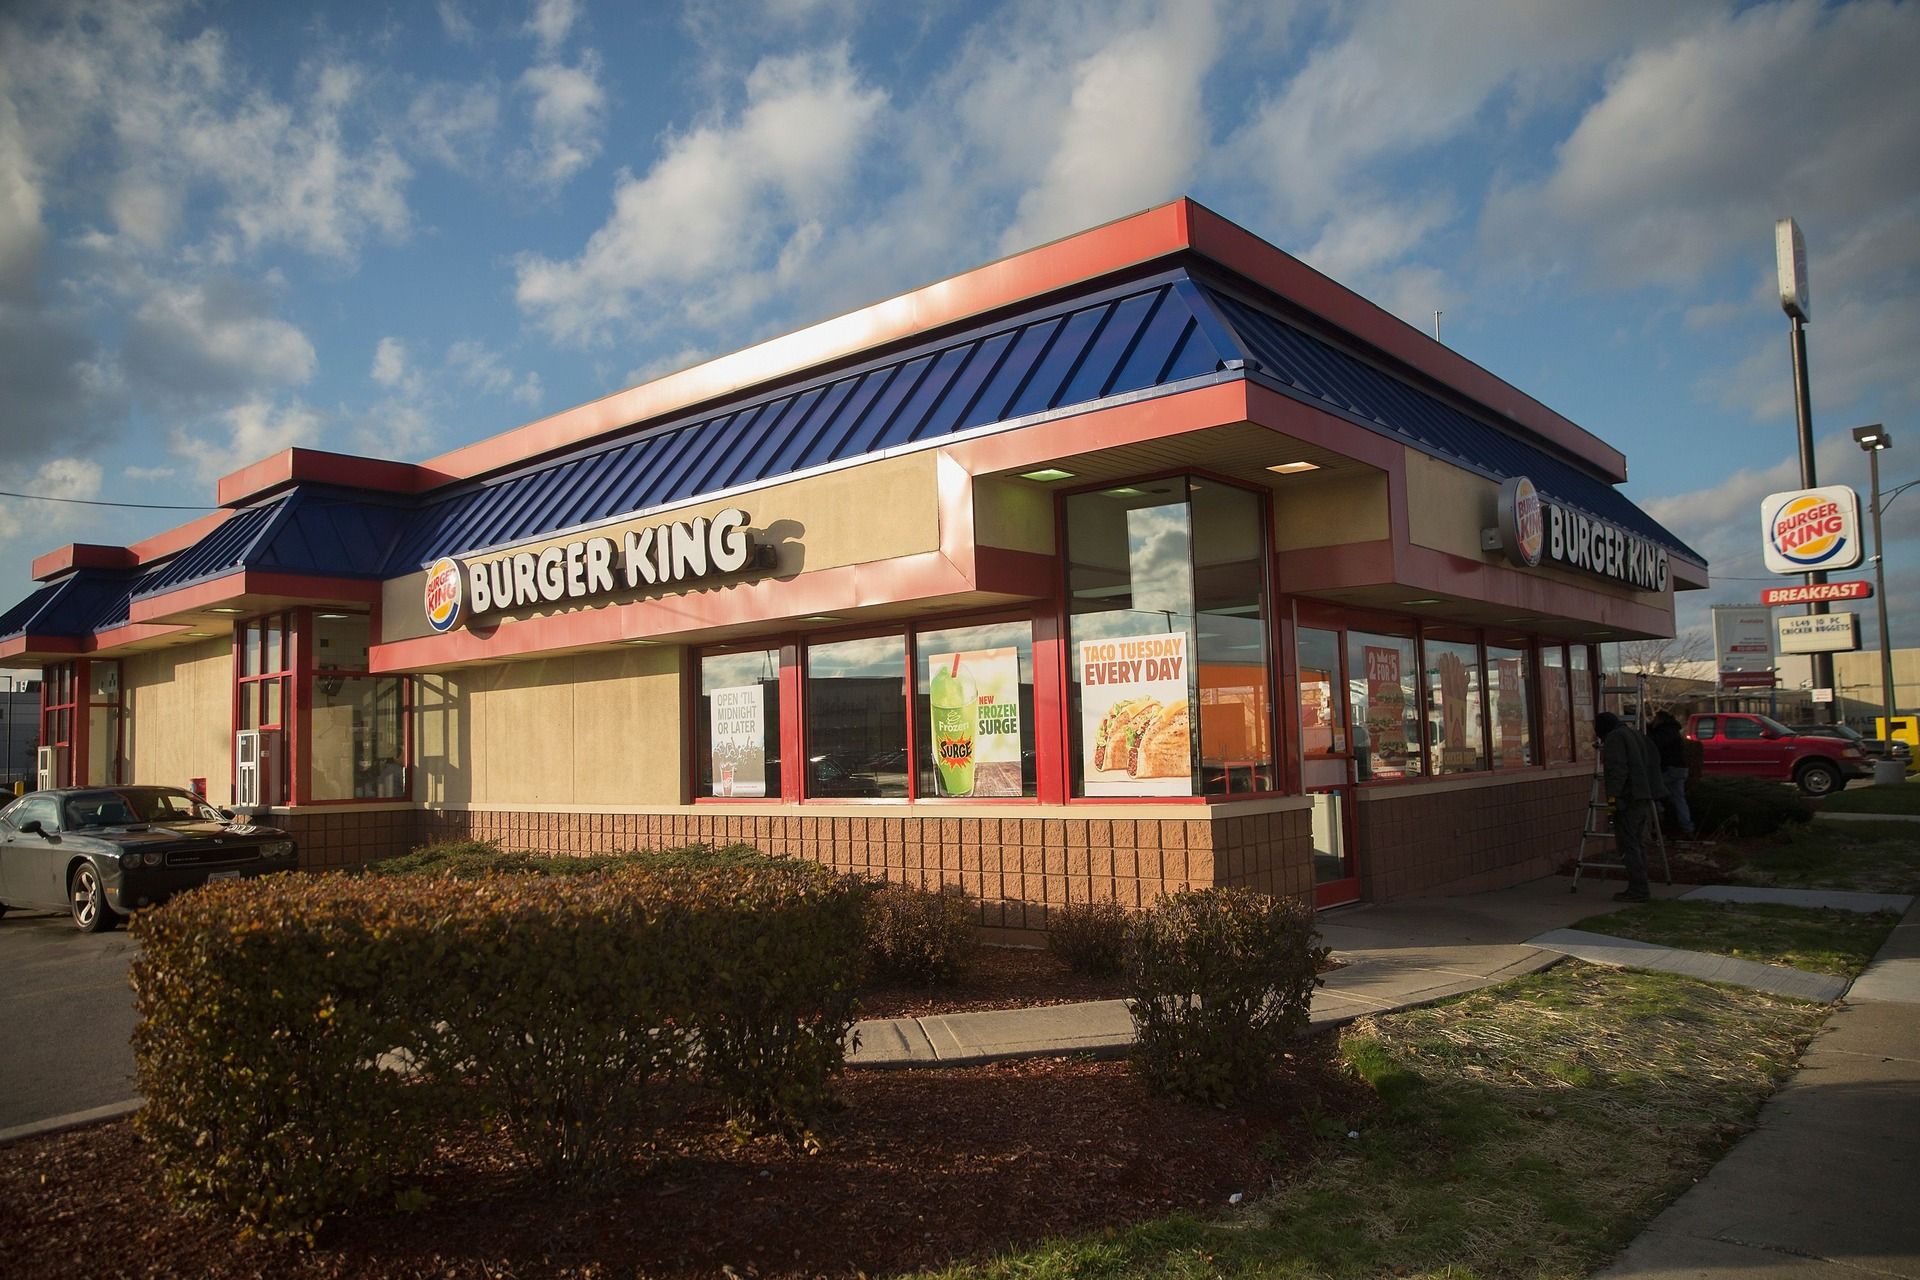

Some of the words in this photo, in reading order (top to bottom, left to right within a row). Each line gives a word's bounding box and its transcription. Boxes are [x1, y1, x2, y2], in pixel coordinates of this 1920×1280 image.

[1776, 502, 1838, 536] BURGER
[1779, 515, 1843, 555] KING
[1550, 503, 1625, 580] BURGER
[1628, 536, 1669, 593] KING
[469, 536, 616, 614] BURGER
[624, 508, 750, 588] KING
[1768, 583, 1860, 603] BREAKFAST
[1781, 627, 1812, 635] CHICKEN
[1815, 624, 1850, 632] NUGGETS
[1083, 644, 1116, 663] TACO
[1118, 638, 1182, 660] TUESDAY
[1084, 660, 1142, 686] EVERY
[1145, 657, 1183, 682] DAY
[1368, 651, 1376, 680] 2
[1376, 663, 1390, 681] FOR
[717, 693, 738, 706] OPEN
[978, 695, 994, 704] NEW
[717, 706, 757, 720] MIDNIGHT
[978, 704, 1017, 719] FROZEN
[717, 722, 728, 735] OR
[731, 720, 755, 734] LATER
[938, 721, 969, 732] Frozen
[978, 718, 1017, 735] SURGE
[940, 740, 972, 758] SURGE
